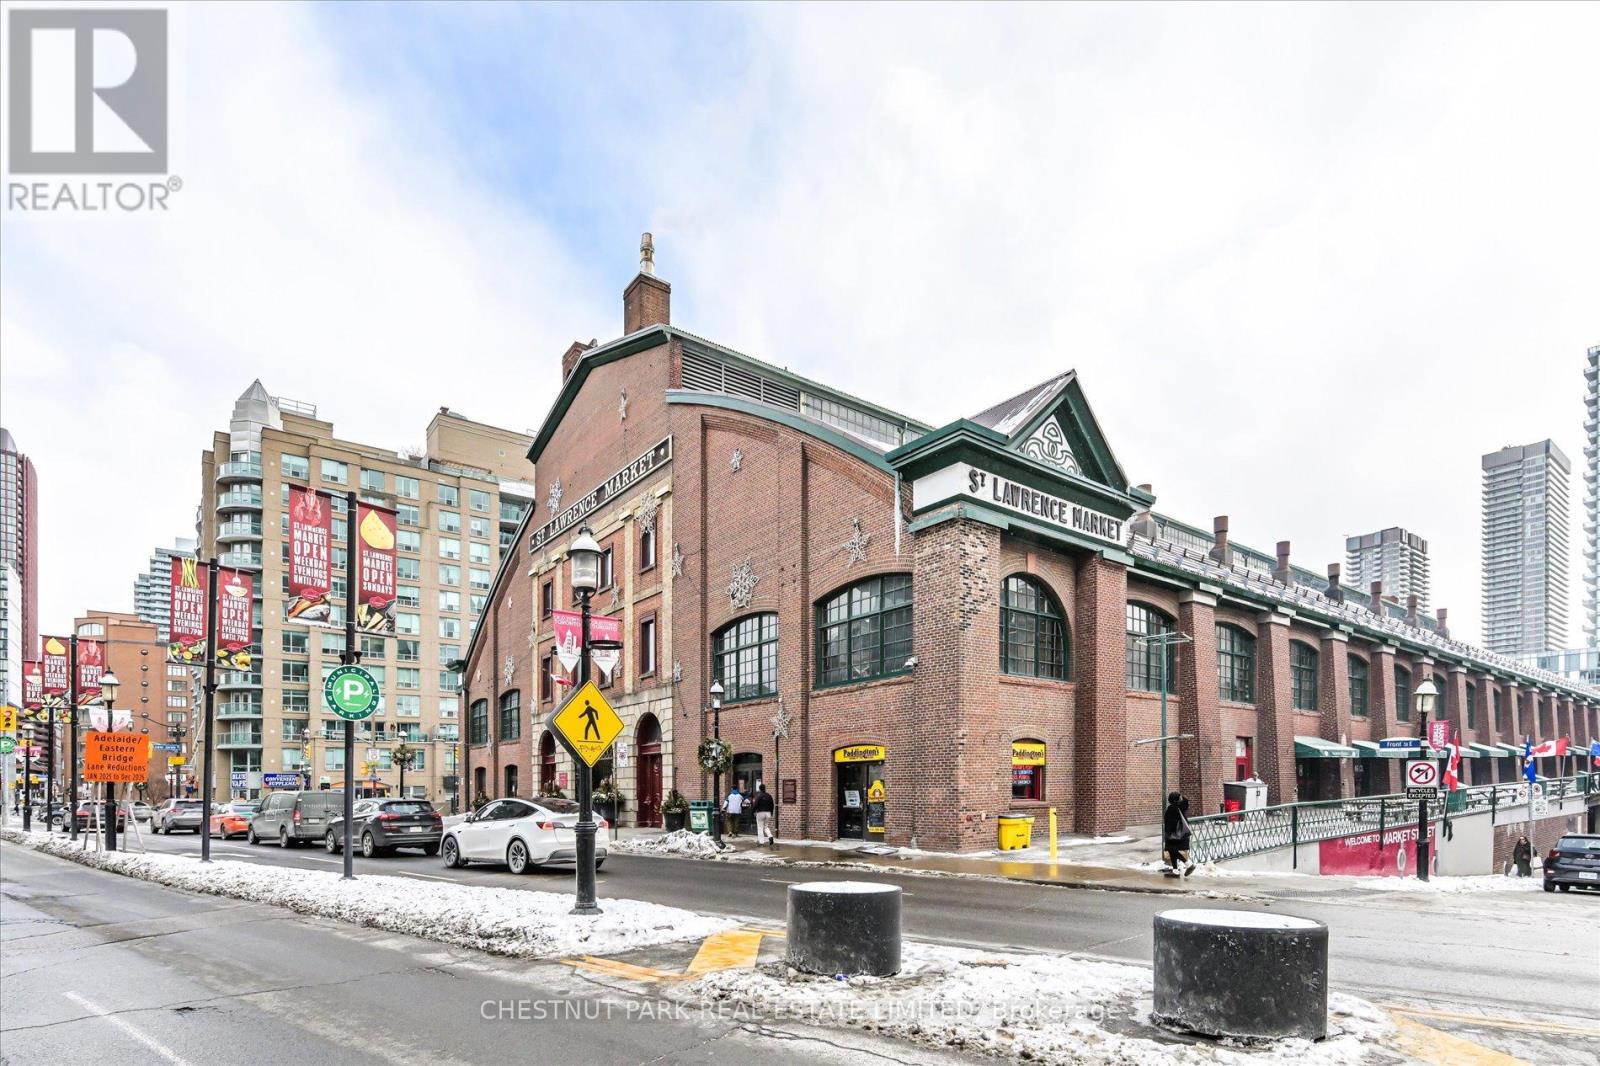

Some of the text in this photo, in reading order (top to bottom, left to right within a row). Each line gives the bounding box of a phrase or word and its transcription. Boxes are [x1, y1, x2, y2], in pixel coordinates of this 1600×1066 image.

[536, 449, 656, 545] ST LAWRENCE MARKET
[968, 468, 1124, 543] ST LAWRENCE MARKET
[301, 523, 328, 537] LAWRENCE
[293, 529, 328, 547] MARKET
[293, 540, 328, 559] OPEN
[294, 554, 328, 571] WEEKDAY
[363, 557, 393, 573] MARKET
[294, 565, 328, 579] EVENINGS
[363, 567, 393, 587] OPEN
[293, 574, 328, 588] UNTIL 7PM
[363, 581, 393, 595] SUNDAYS
[175, 590, 203, 604] MARKET
[174, 600, 203, 614] OPEN
[222, 599, 249, 611] MARKET
[174, 611, 203, 620] WEEKDAY
[222, 607, 249, 621] OPEN
[174, 619, 203, 629] EVENINGS
[222, 618, 249, 628] WEEKDAY
[222, 626, 248, 636] EVENINGS
[45, 664, 67, 675] OPEN
[327, 668, 377, 693] MUNICIPAL
[344, 680, 364, 700] P
[327, 695, 377, 718] PARKING
[94, 734, 142, 745] Adelaide/
[99, 745, 135, 753] Eastern
[843, 746, 880, 758] Paddington's
[1012, 748, 1044, 760] Paddington's
[102, 754, 134, 763] Bridge
[87, 763, 146, 772] Lane Reductions
[232, 780, 246, 788] VAPE
[1344, 835, 1371, 847] WELCOME
[1373, 834, 1380, 843] TO
[1411, 826, 1436, 841] STET
